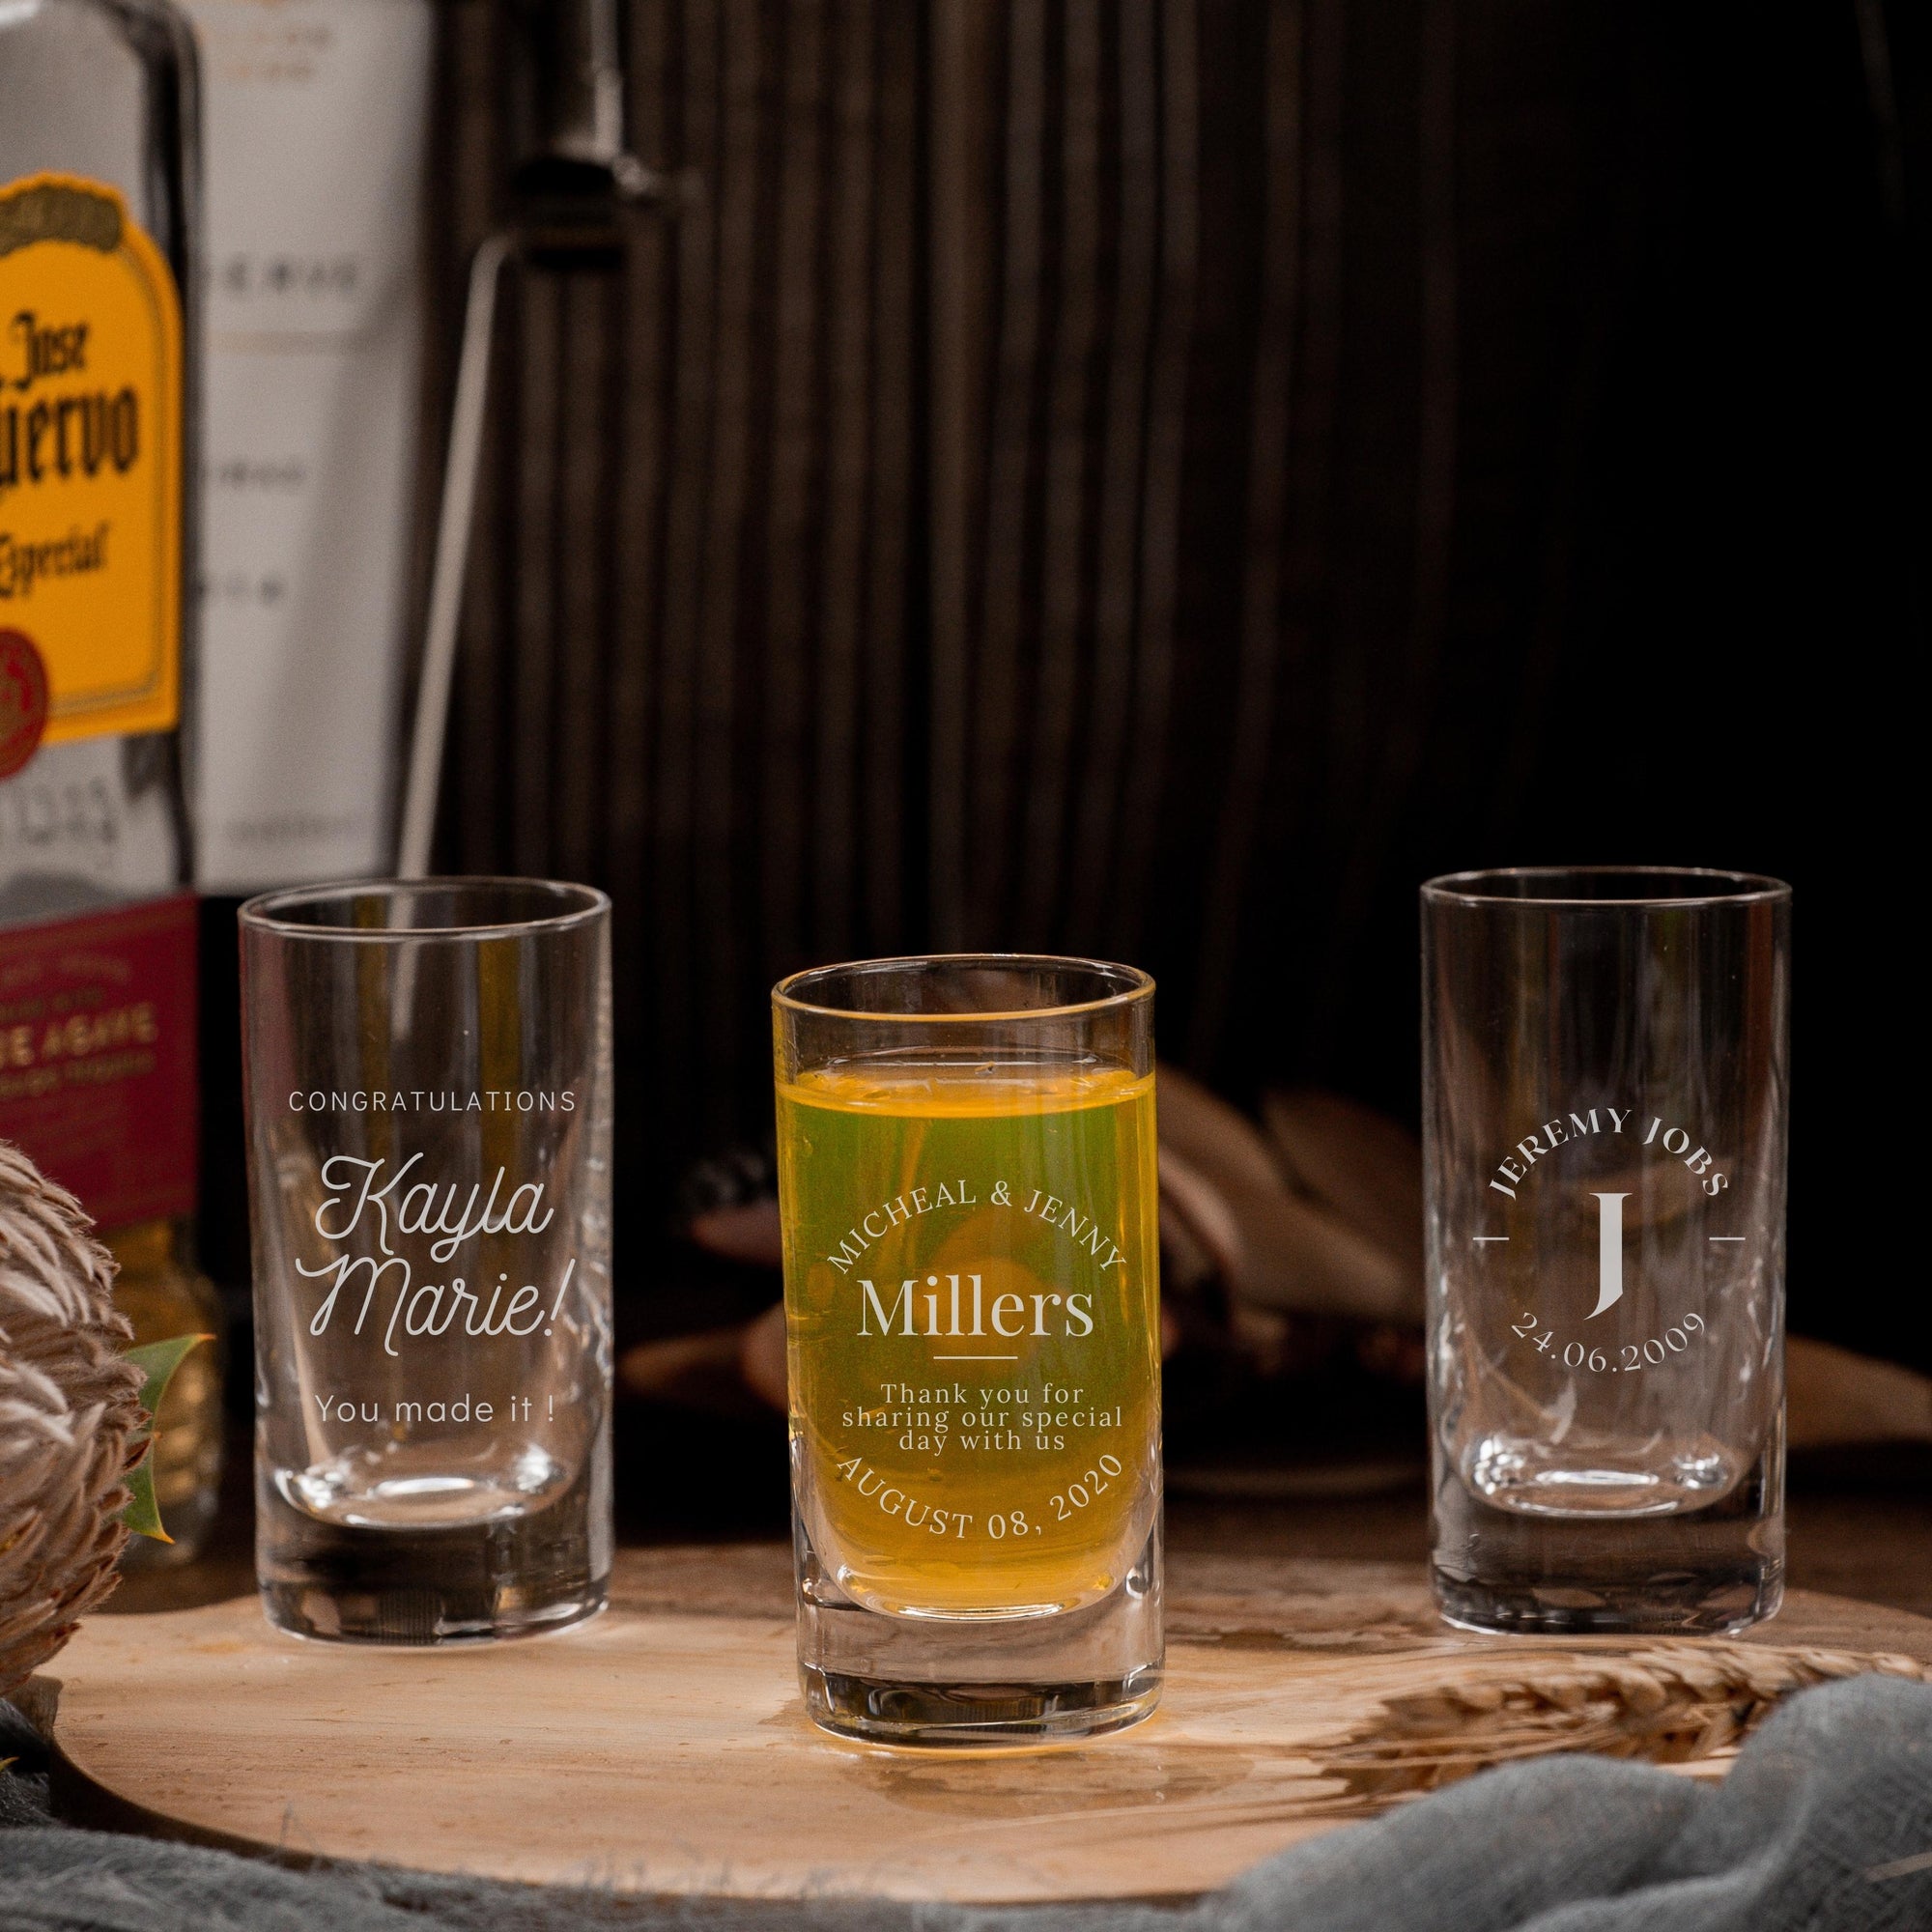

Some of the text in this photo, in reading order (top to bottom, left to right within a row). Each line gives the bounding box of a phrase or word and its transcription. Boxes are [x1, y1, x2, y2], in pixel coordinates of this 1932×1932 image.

[11, 310, 89, 392] Jose
[0, 385, 140, 491] uervo
[289, 1091, 575, 1112] CONGRATULATIONS
[1489, 1108, 1728, 1201] JEREMY JOBS
[315, 1152, 554, 1263] Kayla
[827, 1179, 1126, 1274] MICHEAL & JENNY
[1584, 1192, 1633, 1320] J
[296, 1254, 576, 1356] Marie!
[857, 1274, 1094, 1337] Millers
[1511, 1312, 1705, 1373] 24.06.2009
[315, 1395, 379, 1422] You
[395, 1393, 494, 1423] made
[510, 1395, 532, 1422] it
[842, 1406, 1122, 1433] sharing our special
[880, 1382, 1084, 1409] Thank you for
[899, 1430, 1065, 1456] day with us
[837, 1453, 1122, 1539] AUGUST 08, 2020
